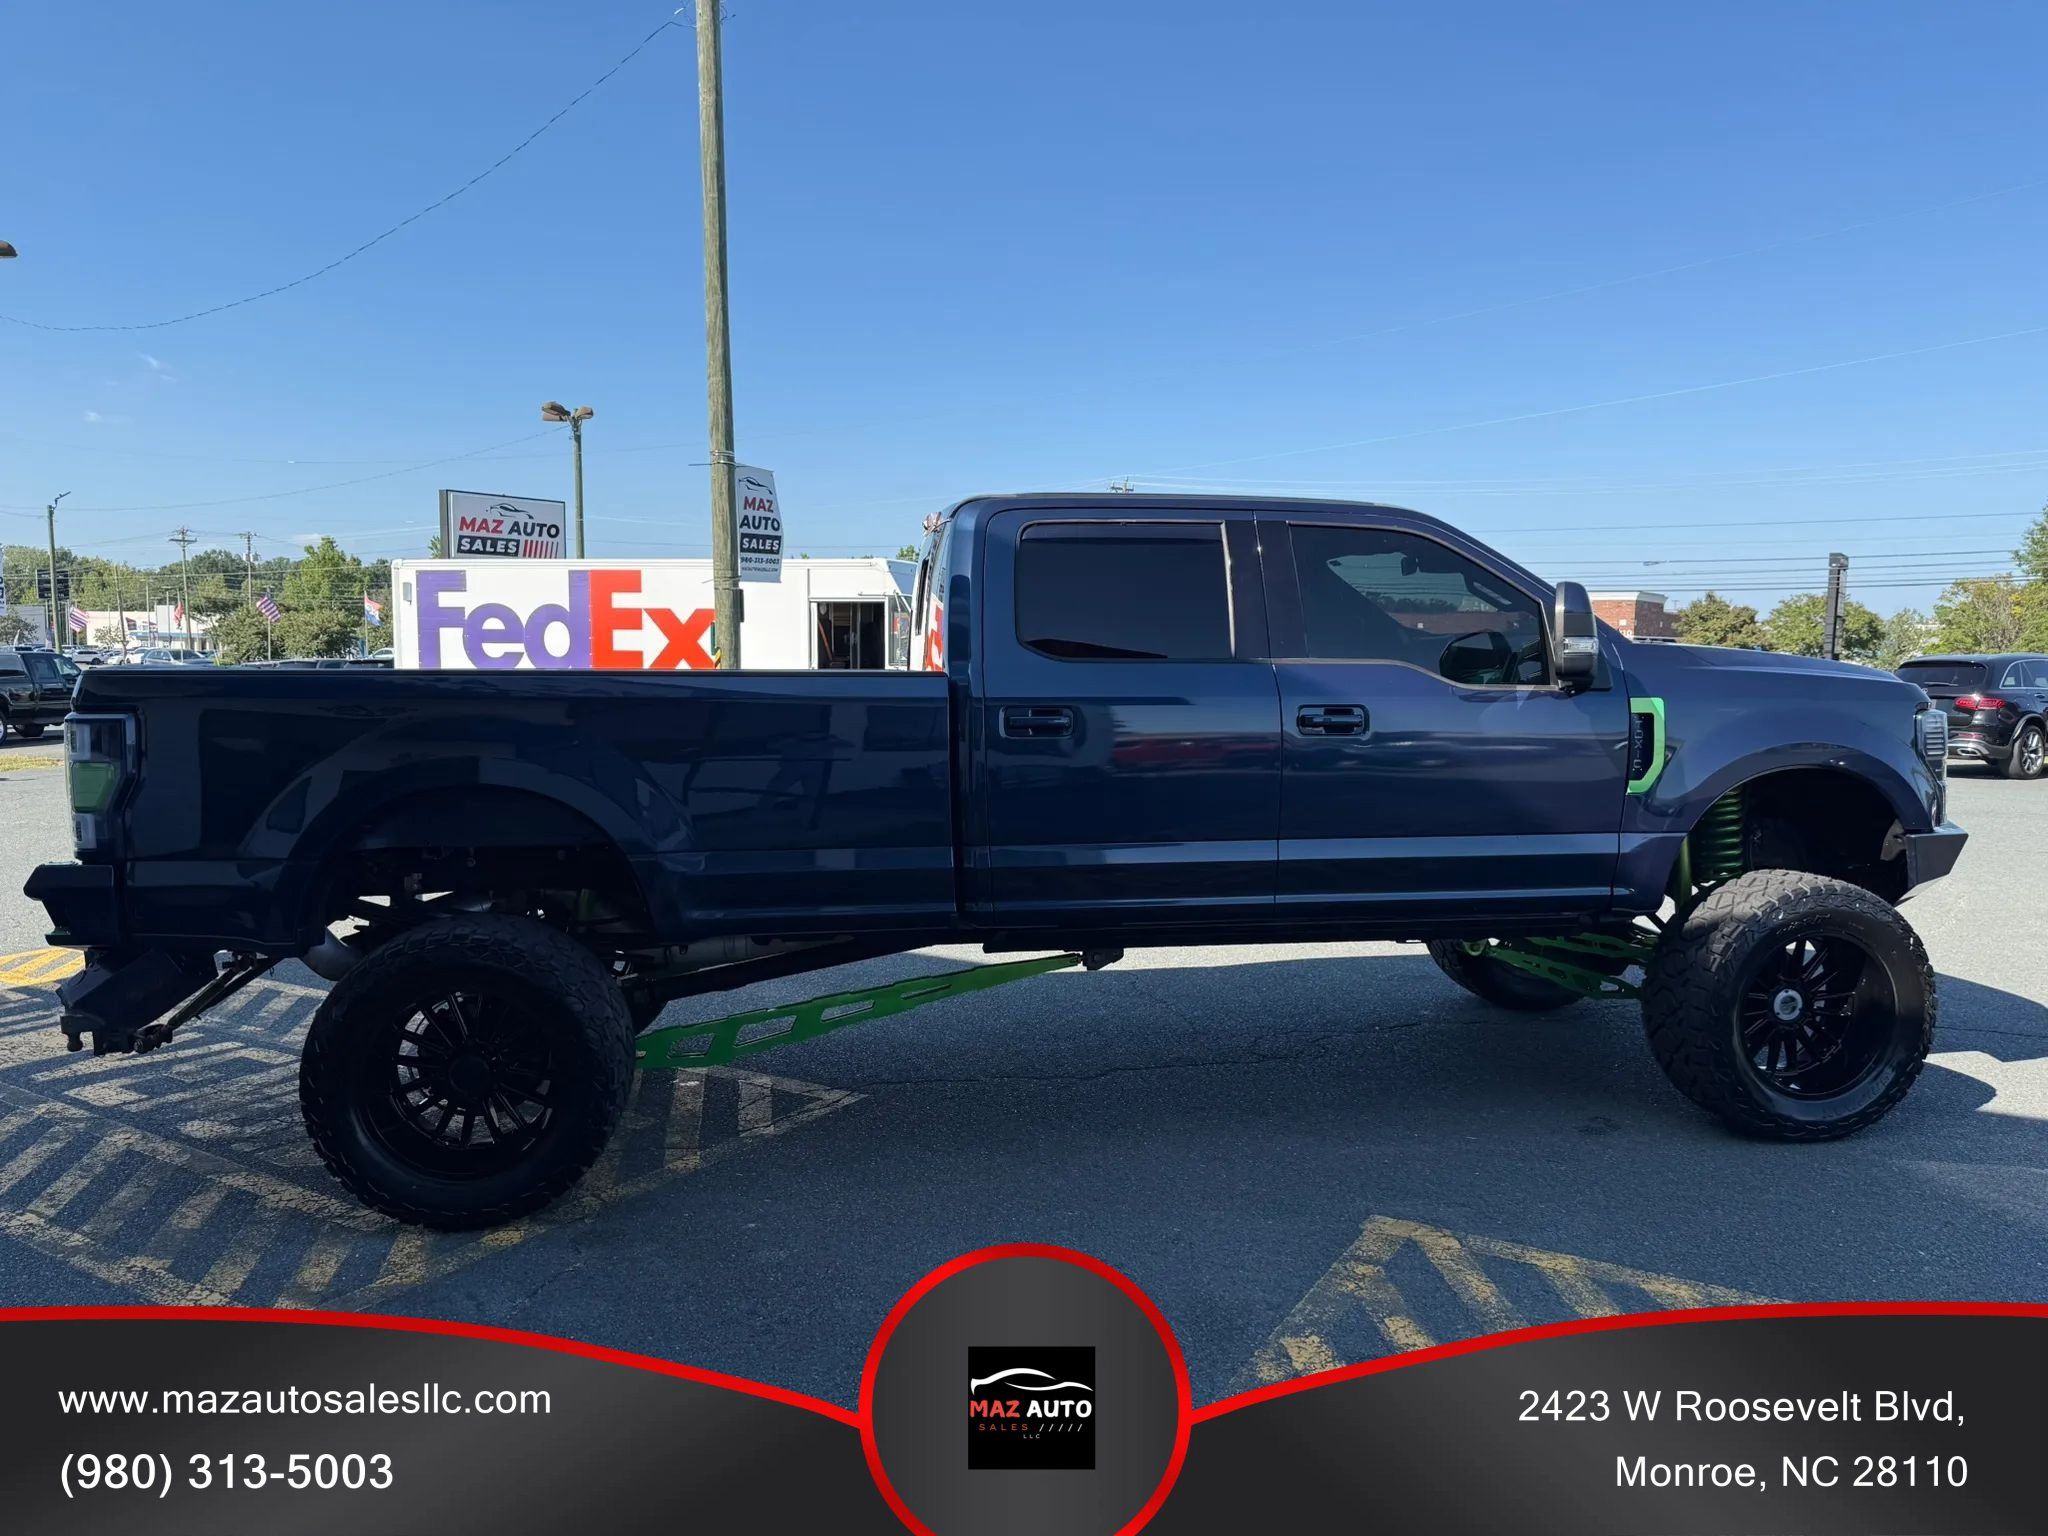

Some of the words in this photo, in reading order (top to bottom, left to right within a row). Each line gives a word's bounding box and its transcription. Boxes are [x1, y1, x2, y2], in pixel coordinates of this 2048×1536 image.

[743, 495, 774, 513] MAZ
[460, 516, 504, 534] MAZ
[508, 520, 560, 539] AUTO
[739, 514, 780, 532] AUTO
[460, 537, 517, 553] SALES
[742, 537, 779, 551] SALES
[415, 569, 718, 670] FedEx
